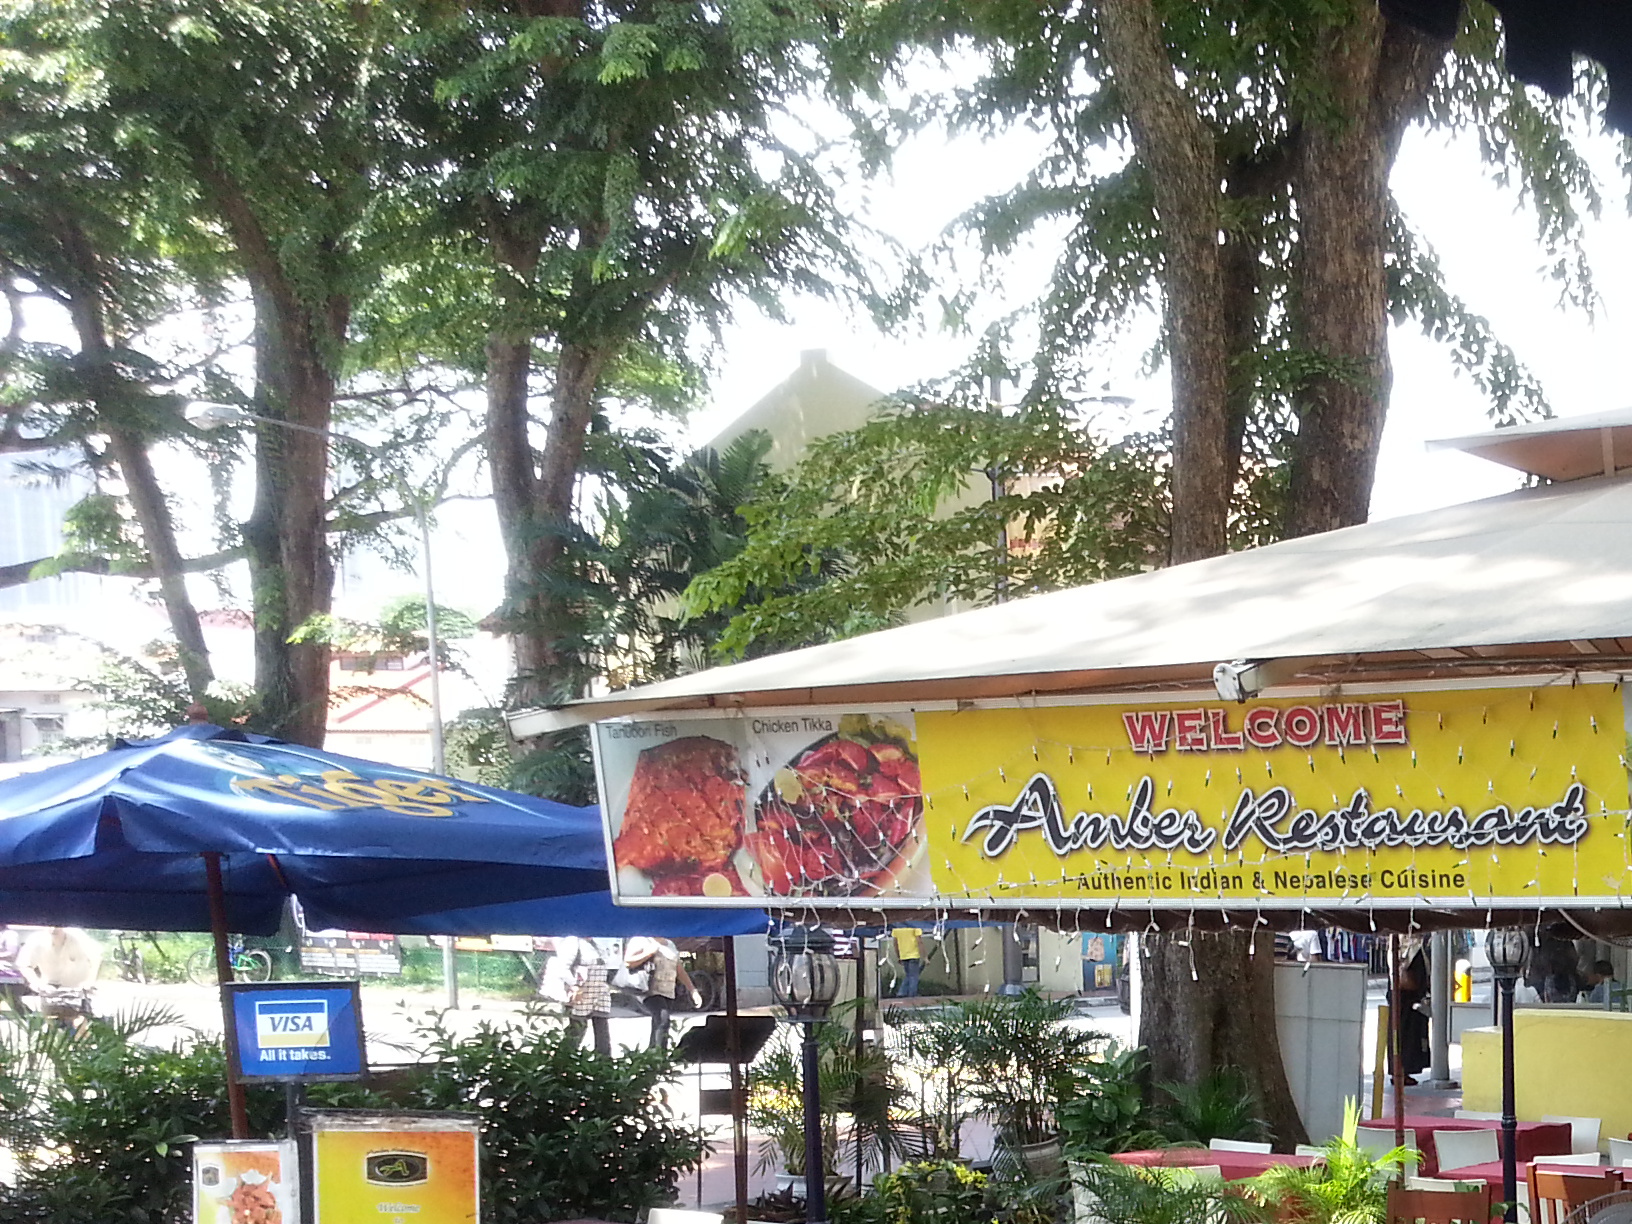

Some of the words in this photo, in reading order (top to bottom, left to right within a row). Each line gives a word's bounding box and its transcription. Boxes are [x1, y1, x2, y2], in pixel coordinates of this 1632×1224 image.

[655, 723, 677, 736] Fish
[752, 719, 798, 734] Chicken
[801, 718, 832, 732] Tikka
[1122, 700, 1406, 751] WELCOME
[961, 772, 1216, 856] Amber
[1222, 782, 1588, 851] Restaurant
[1076, 871, 1172, 890] Authentic
[1180, 870, 1243, 889] Indian
[1252, 872, 1265, 890] &
[1274, 869, 1372, 892] Nepalese
[1381, 868, 1465, 889] Cuisine
[268, 1015, 314, 1032] VISA
[260, 1049, 276, 1061] All
[278, 1049, 287, 1061] it
[290, 1048, 331, 1061] takes.
[377, 1202, 421, 1213] Welcome
